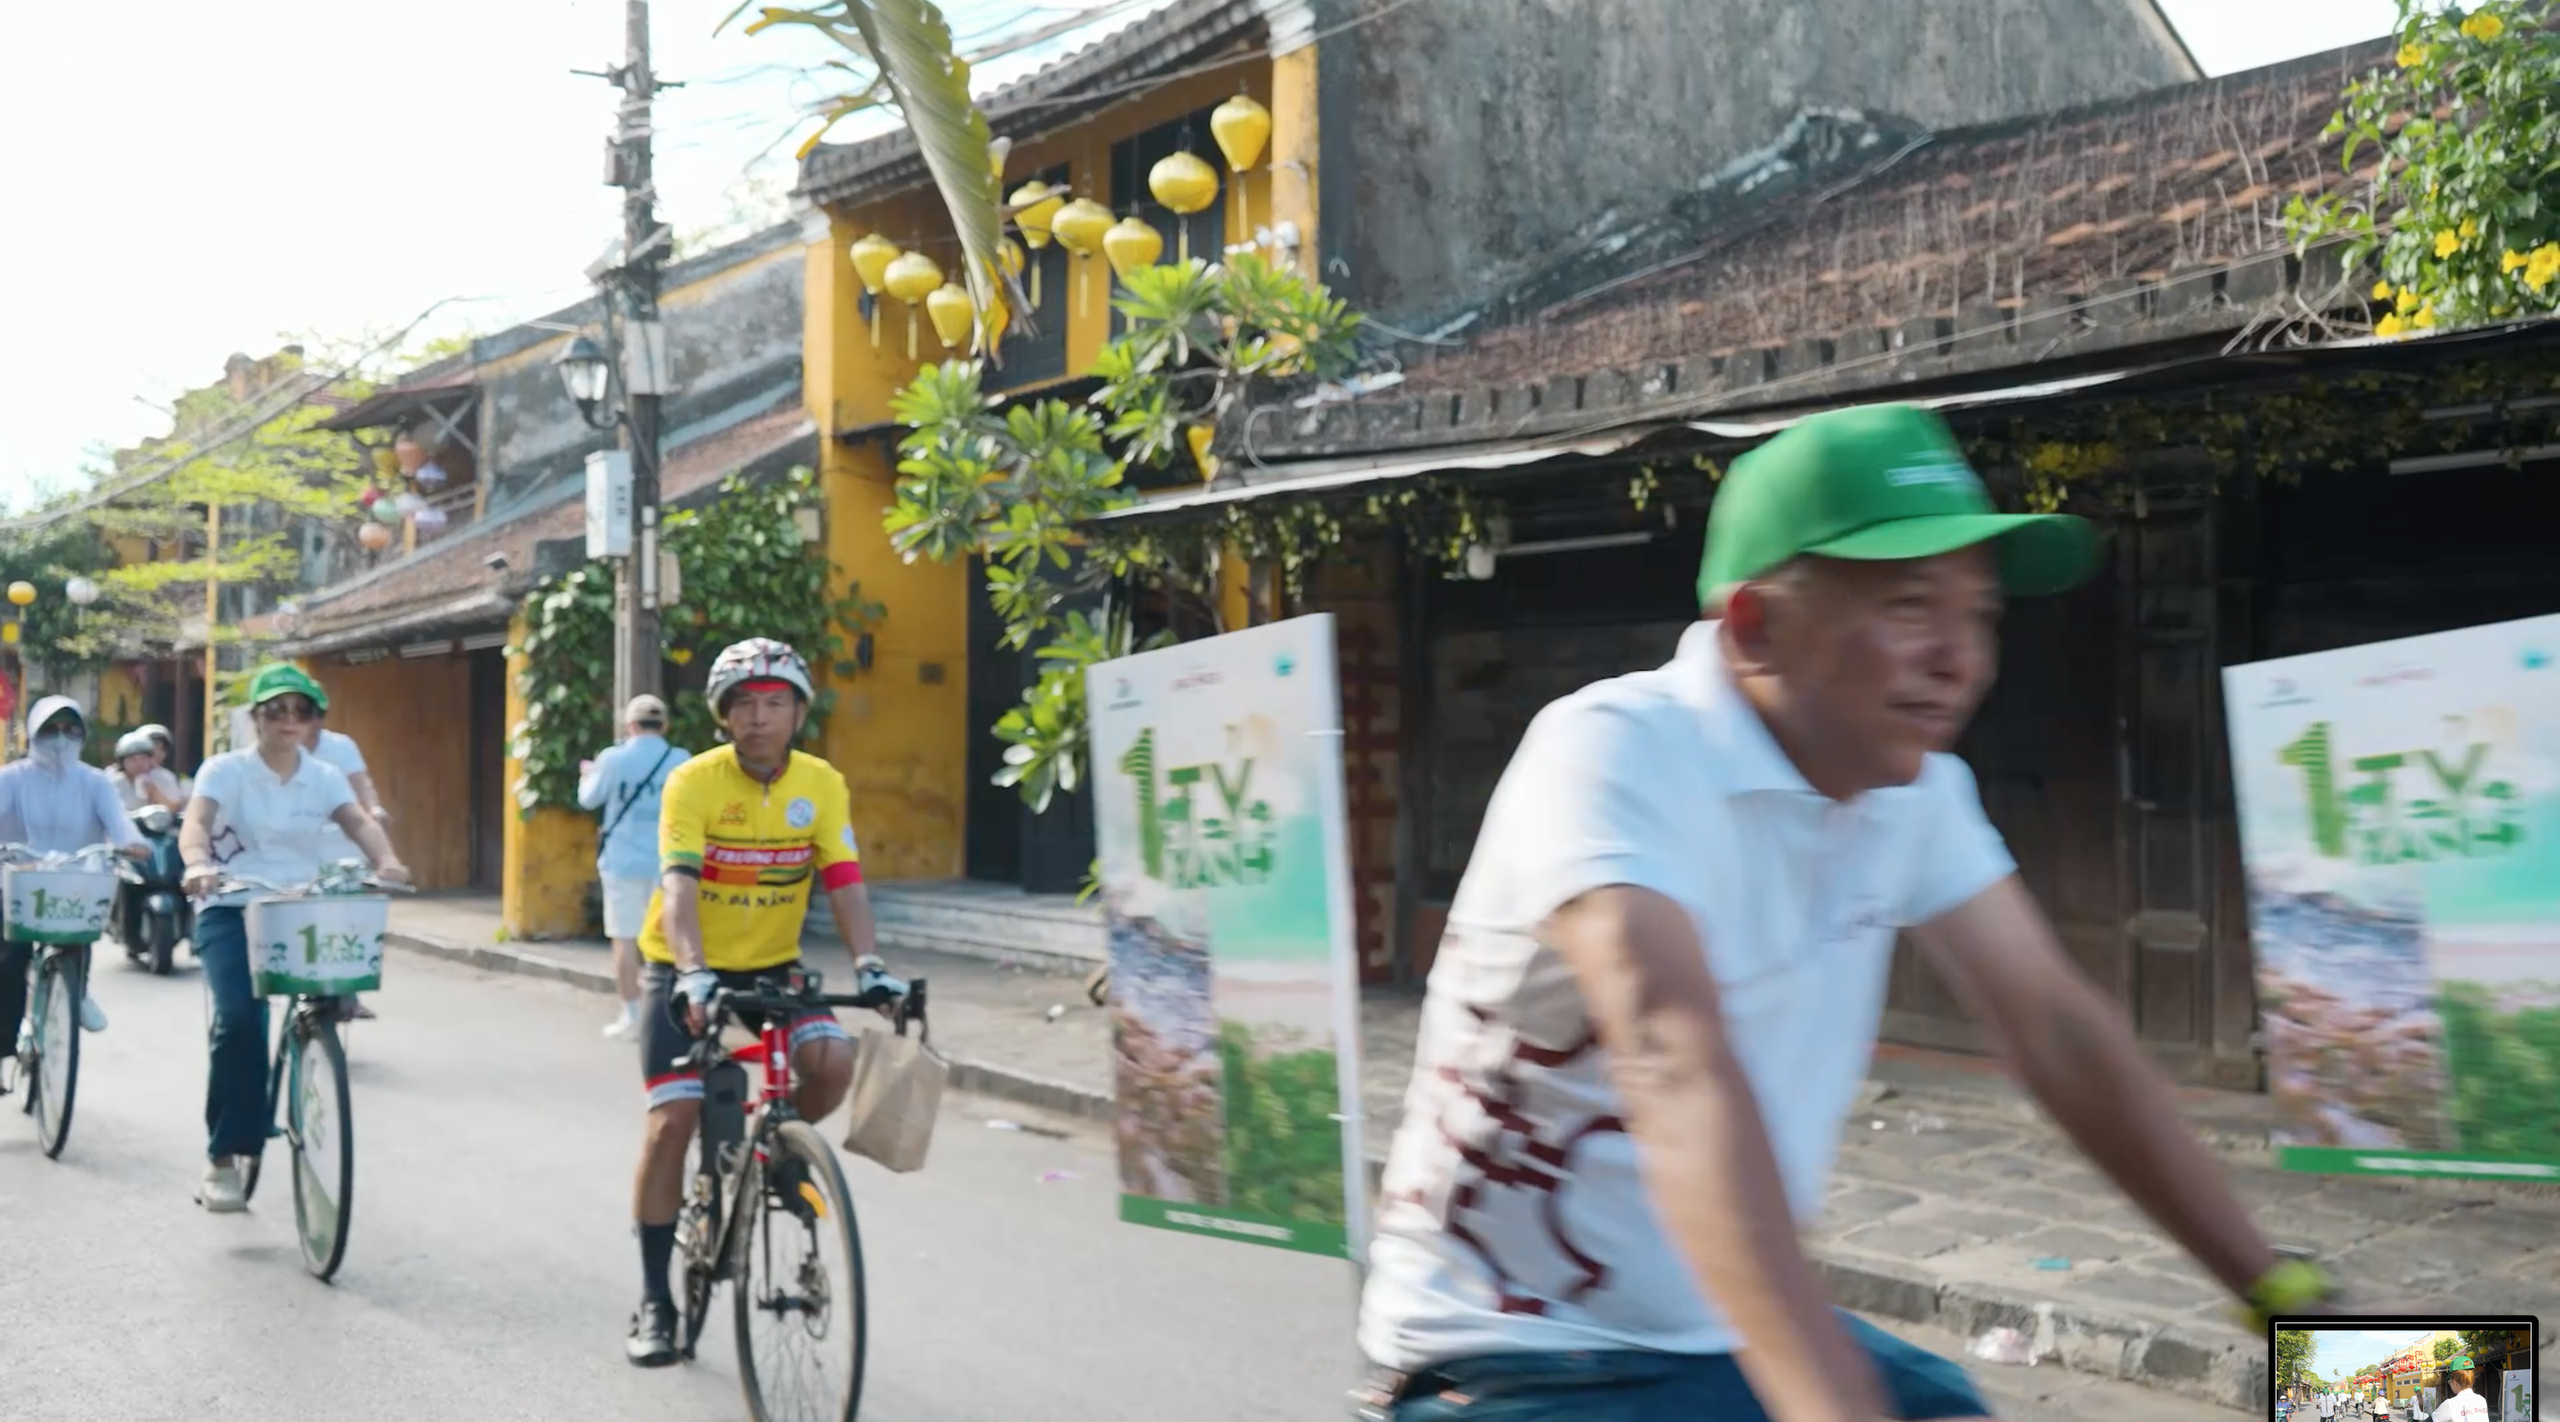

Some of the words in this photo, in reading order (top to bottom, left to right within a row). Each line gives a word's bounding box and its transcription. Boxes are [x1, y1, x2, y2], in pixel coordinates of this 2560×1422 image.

[1118, 726, 1164, 881] 1
[2277, 721, 2346, 860] 1
[30, 887, 46, 919] 1
[297, 923, 317, 964] 1
